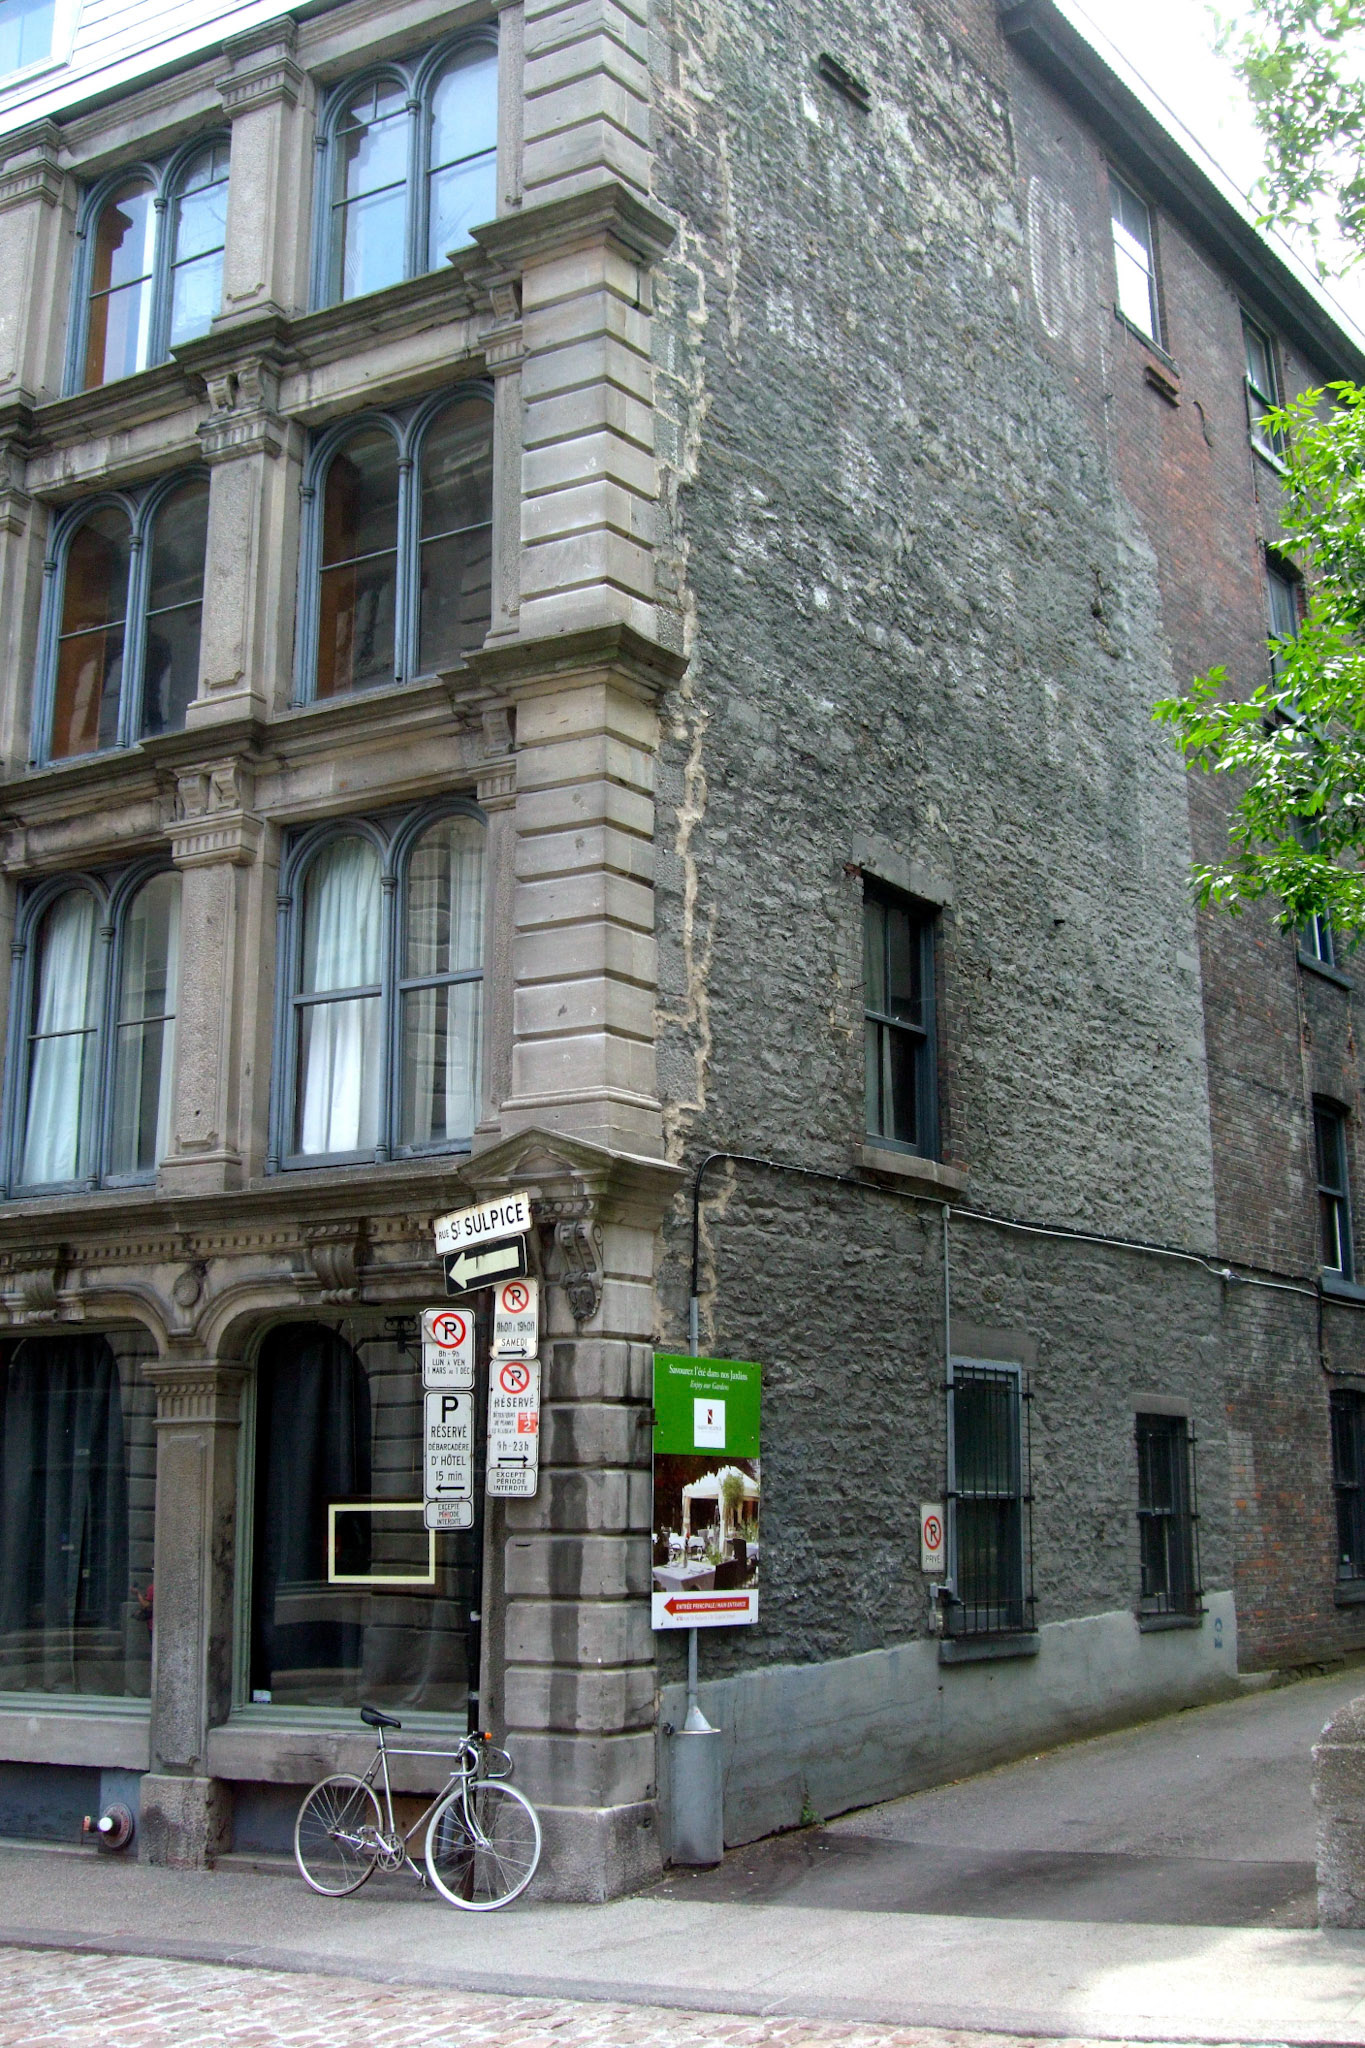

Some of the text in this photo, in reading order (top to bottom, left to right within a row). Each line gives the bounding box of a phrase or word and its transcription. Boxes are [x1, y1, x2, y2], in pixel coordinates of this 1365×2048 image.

[438, 1229, 450, 1241] RUE
[464, 1203, 524, 1236] SULPICE
[444, 1321, 457, 1340] P
[501, 1338, 528, 1347] SAMEDI
[432, 1366, 446, 1375] MARS
[494, 1394, 534, 1408] RÉSERVÉ
[441, 1396, 459, 1423] P
[430, 1425, 468, 1438] RÉSERVÉ
[523, 1421, 532, 1433] 2
[435, 1471, 463, 1481] 15 min
